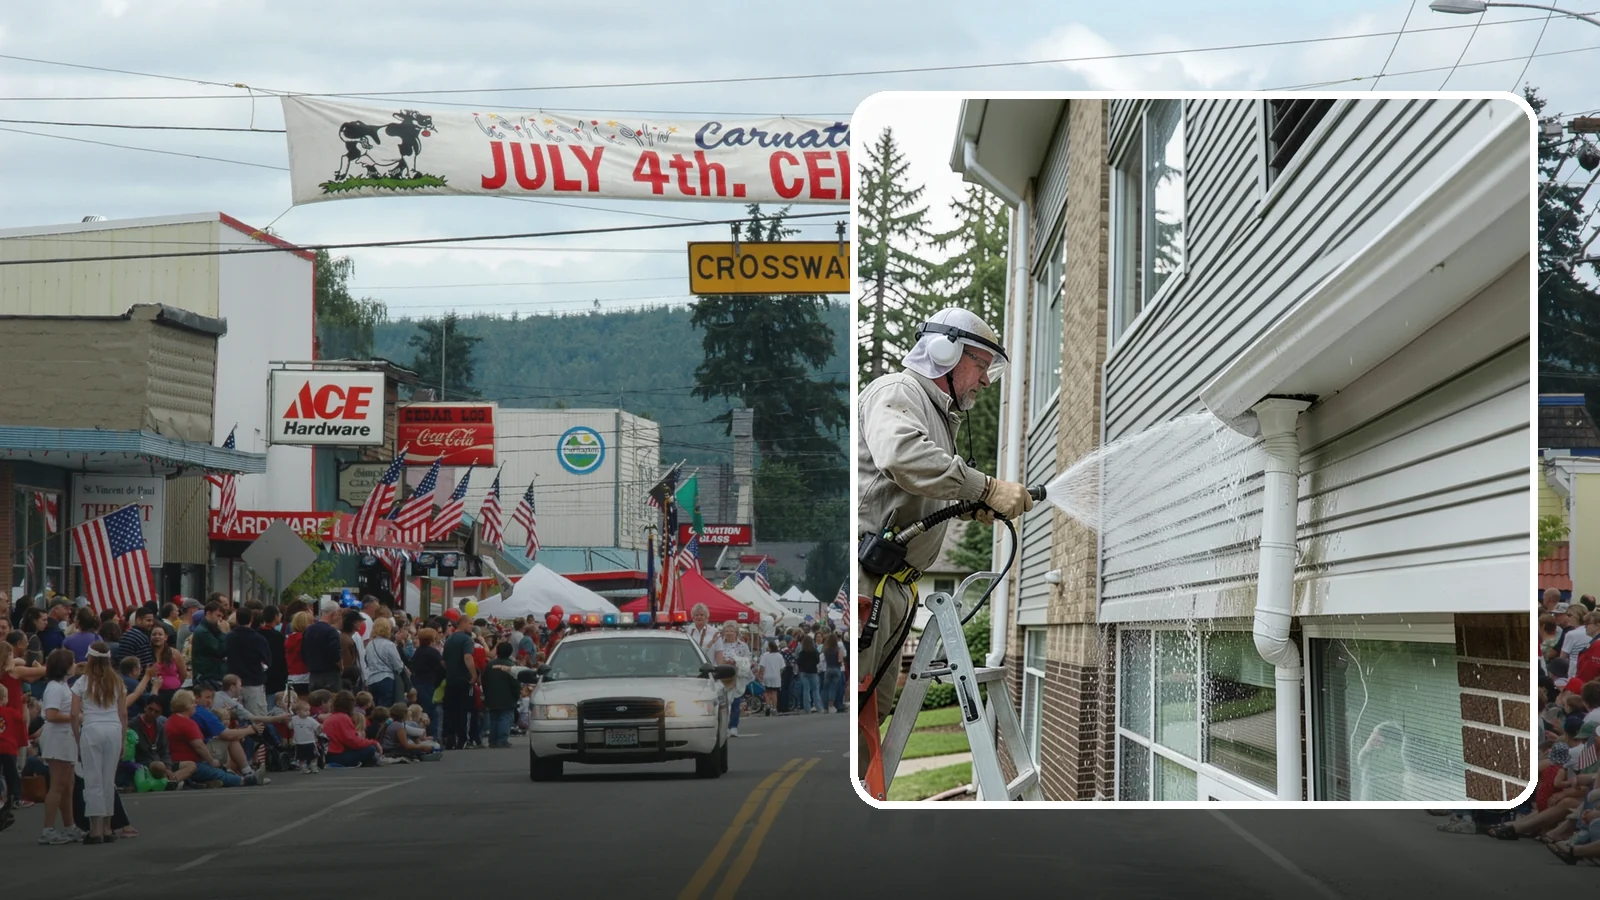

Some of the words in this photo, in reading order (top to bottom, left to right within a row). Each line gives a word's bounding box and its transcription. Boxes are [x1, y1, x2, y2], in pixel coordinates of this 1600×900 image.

[695, 121, 850, 149] Carnat
[481, 141, 605, 192] JULY
[632, 150, 746, 198] 4th.
[697, 254, 850, 280] CROSSWA
[283, 380, 373, 420] ACE
[405, 409, 452, 422] CEDAR
[284, 421, 371, 437] Hardware
[95, 485, 124, 495] Vincent
[126, 486, 135, 495] de
[137, 485, 155, 495] Paul
[688, 526, 741, 535] CRNATION
[699, 535, 730, 543] GLASS
